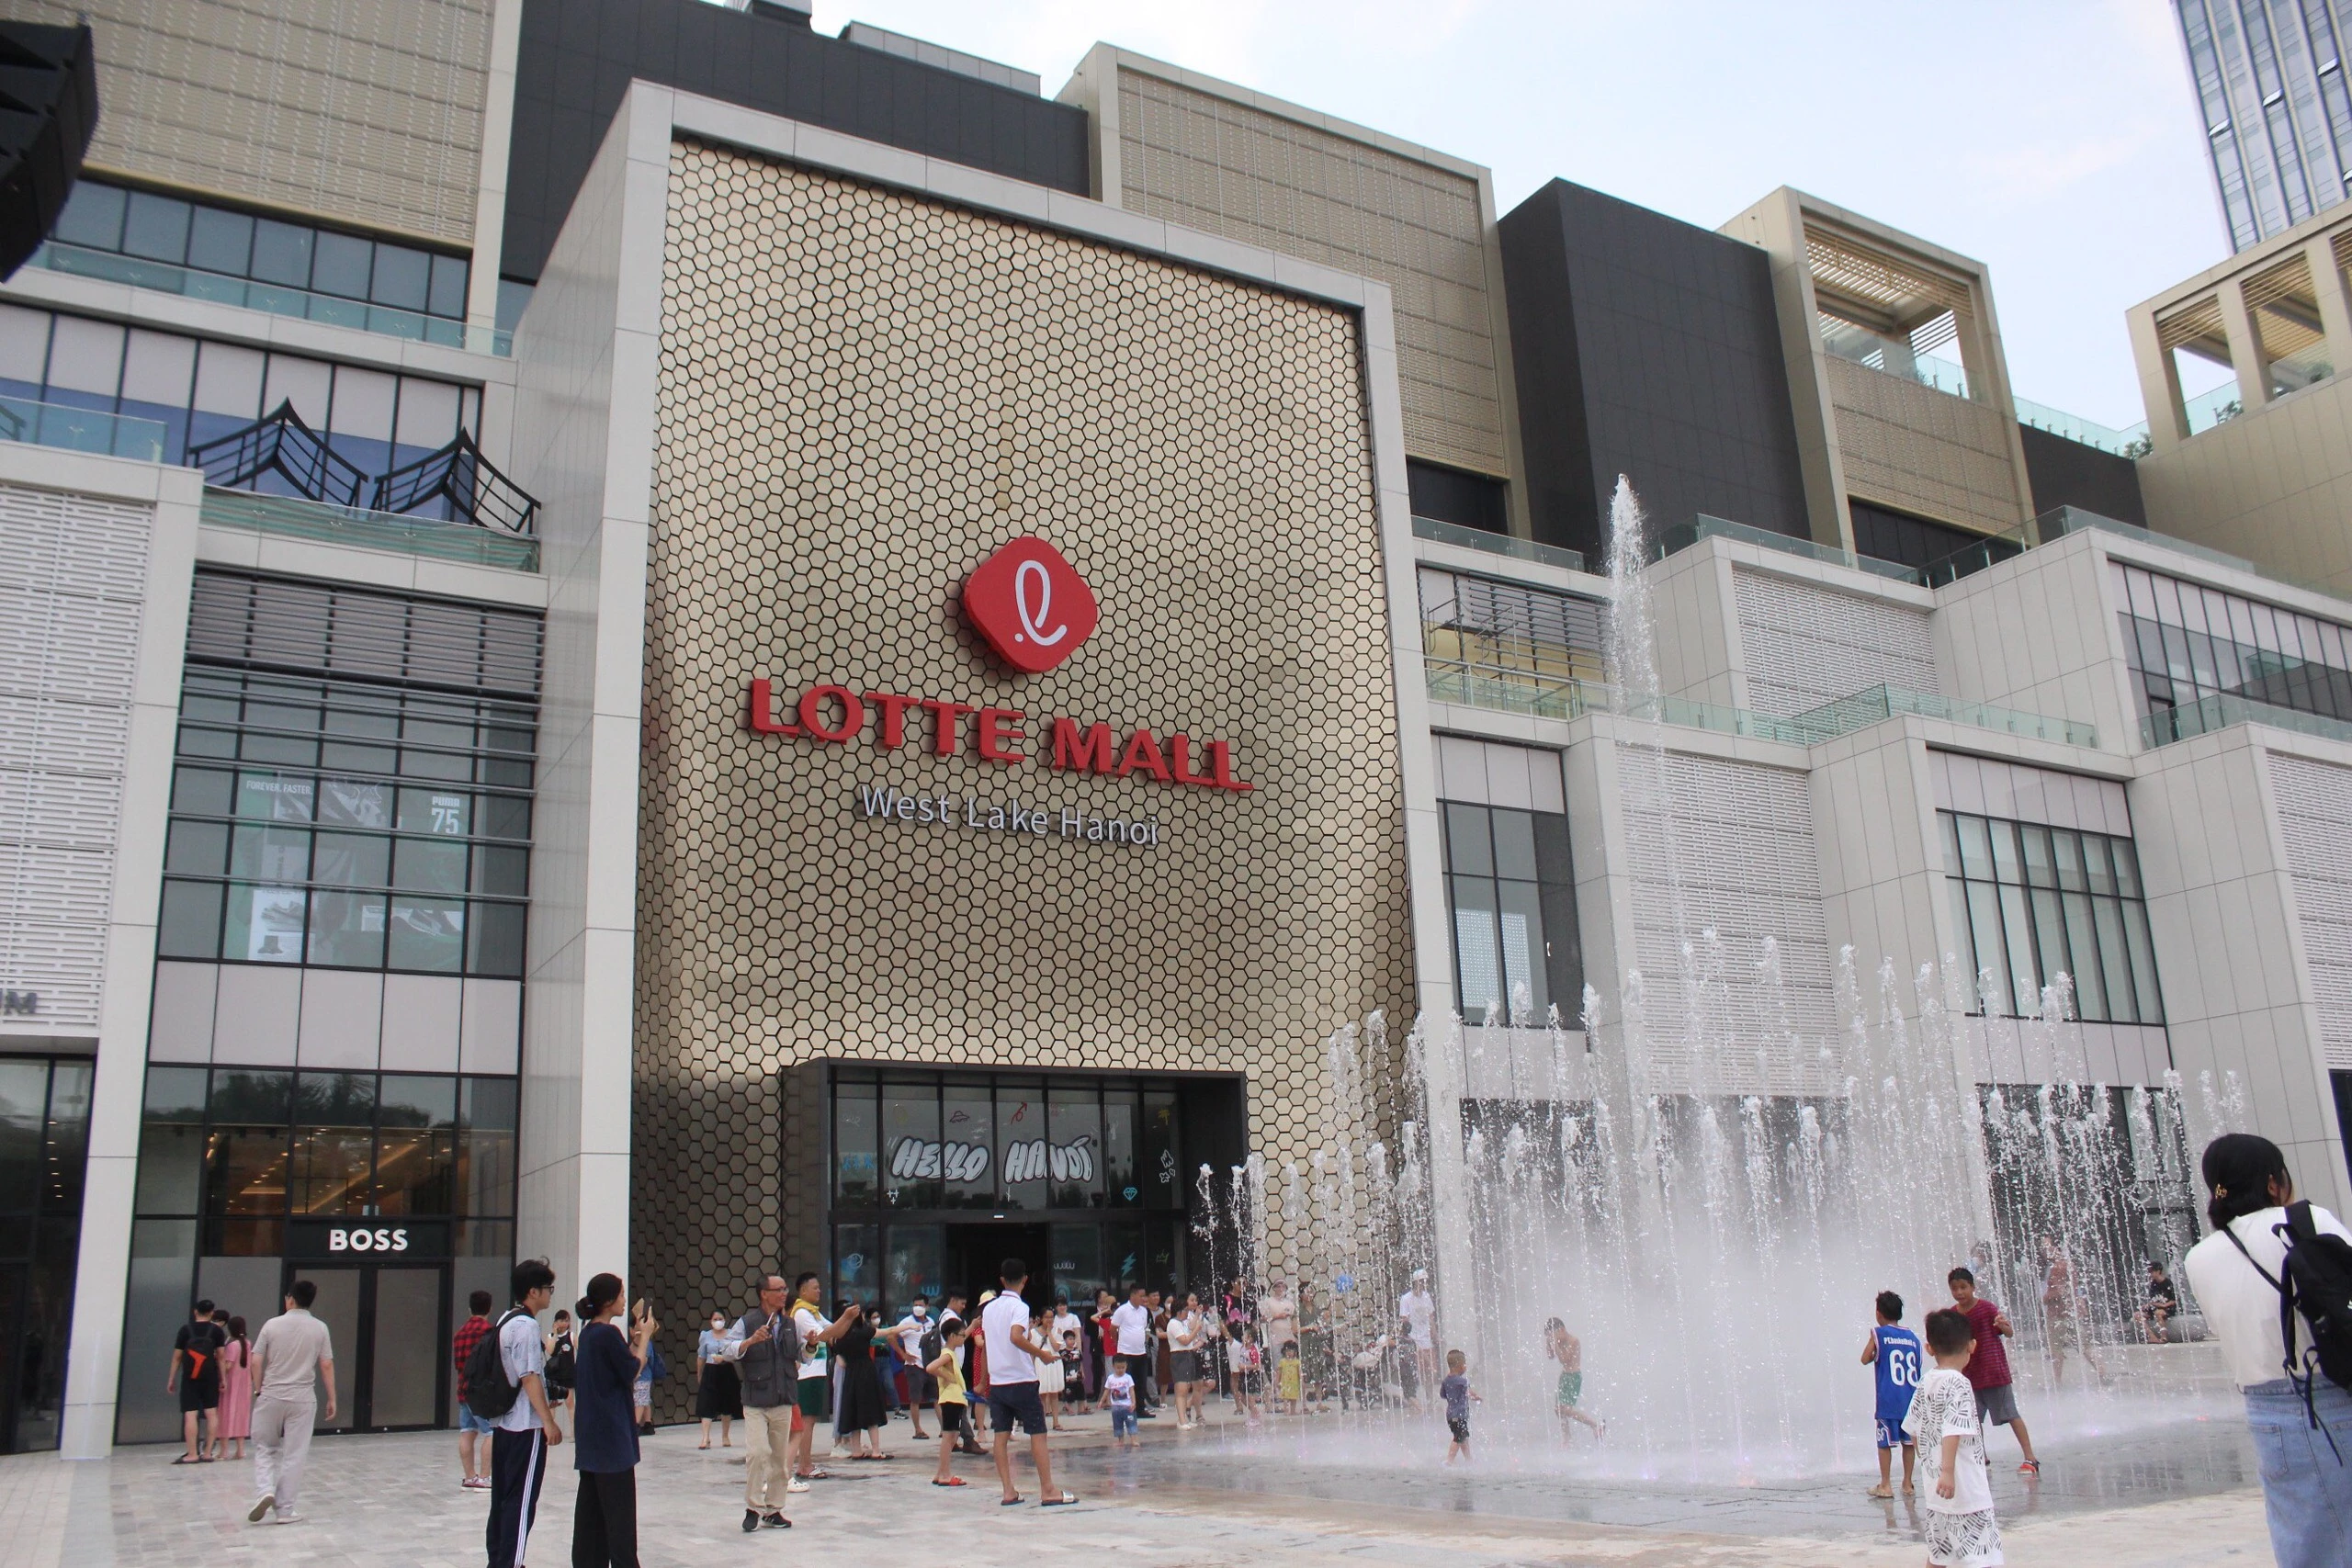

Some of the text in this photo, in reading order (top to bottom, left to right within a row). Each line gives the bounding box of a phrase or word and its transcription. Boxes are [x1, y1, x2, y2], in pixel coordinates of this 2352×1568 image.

[752, 678, 1254, 792] LOTTE MALL
[432, 795, 460, 807] PUMA
[860, 784, 1159, 846] West Lake Hanoi
[431, 807, 460, 834] 75
[329, 1228, 409, 1251] BOSS
[1889, 1349, 1919, 1388] 68
